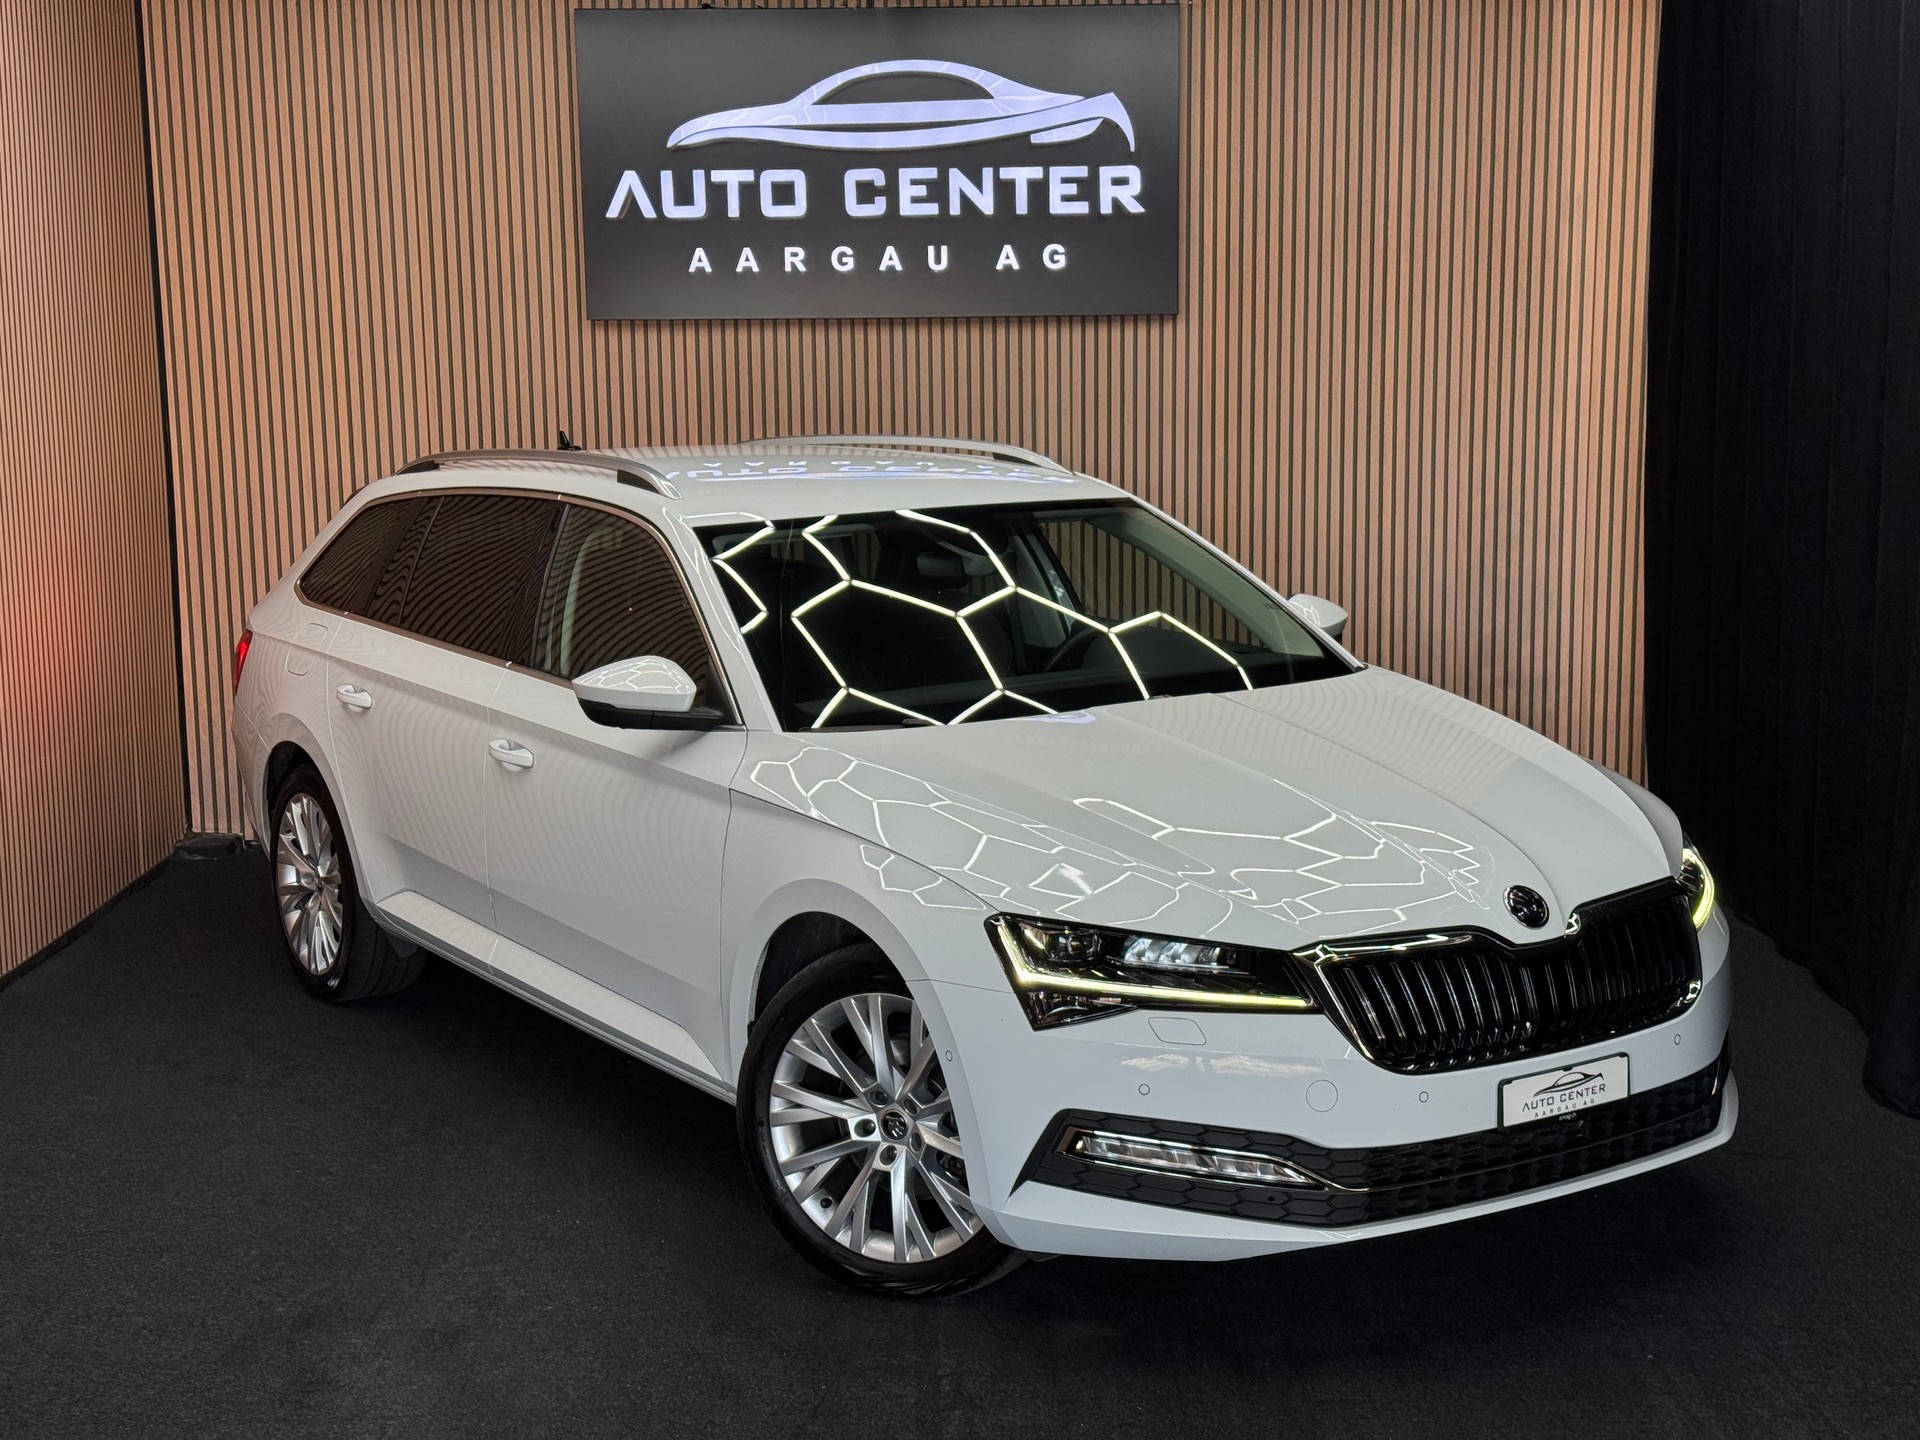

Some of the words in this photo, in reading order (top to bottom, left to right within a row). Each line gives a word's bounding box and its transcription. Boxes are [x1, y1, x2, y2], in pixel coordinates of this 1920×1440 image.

[605, 168, 808, 219] AUTO
[843, 164, 1146, 217] CENTER
[688, 245, 949, 273] AARGAU
[996, 243, 1068, 270] AG
[1522, 1096, 1555, 1112] AUTO
[1560, 1083, 1606, 1102] CENTER
[1534, 1103, 1577, 1117] AARGAU
